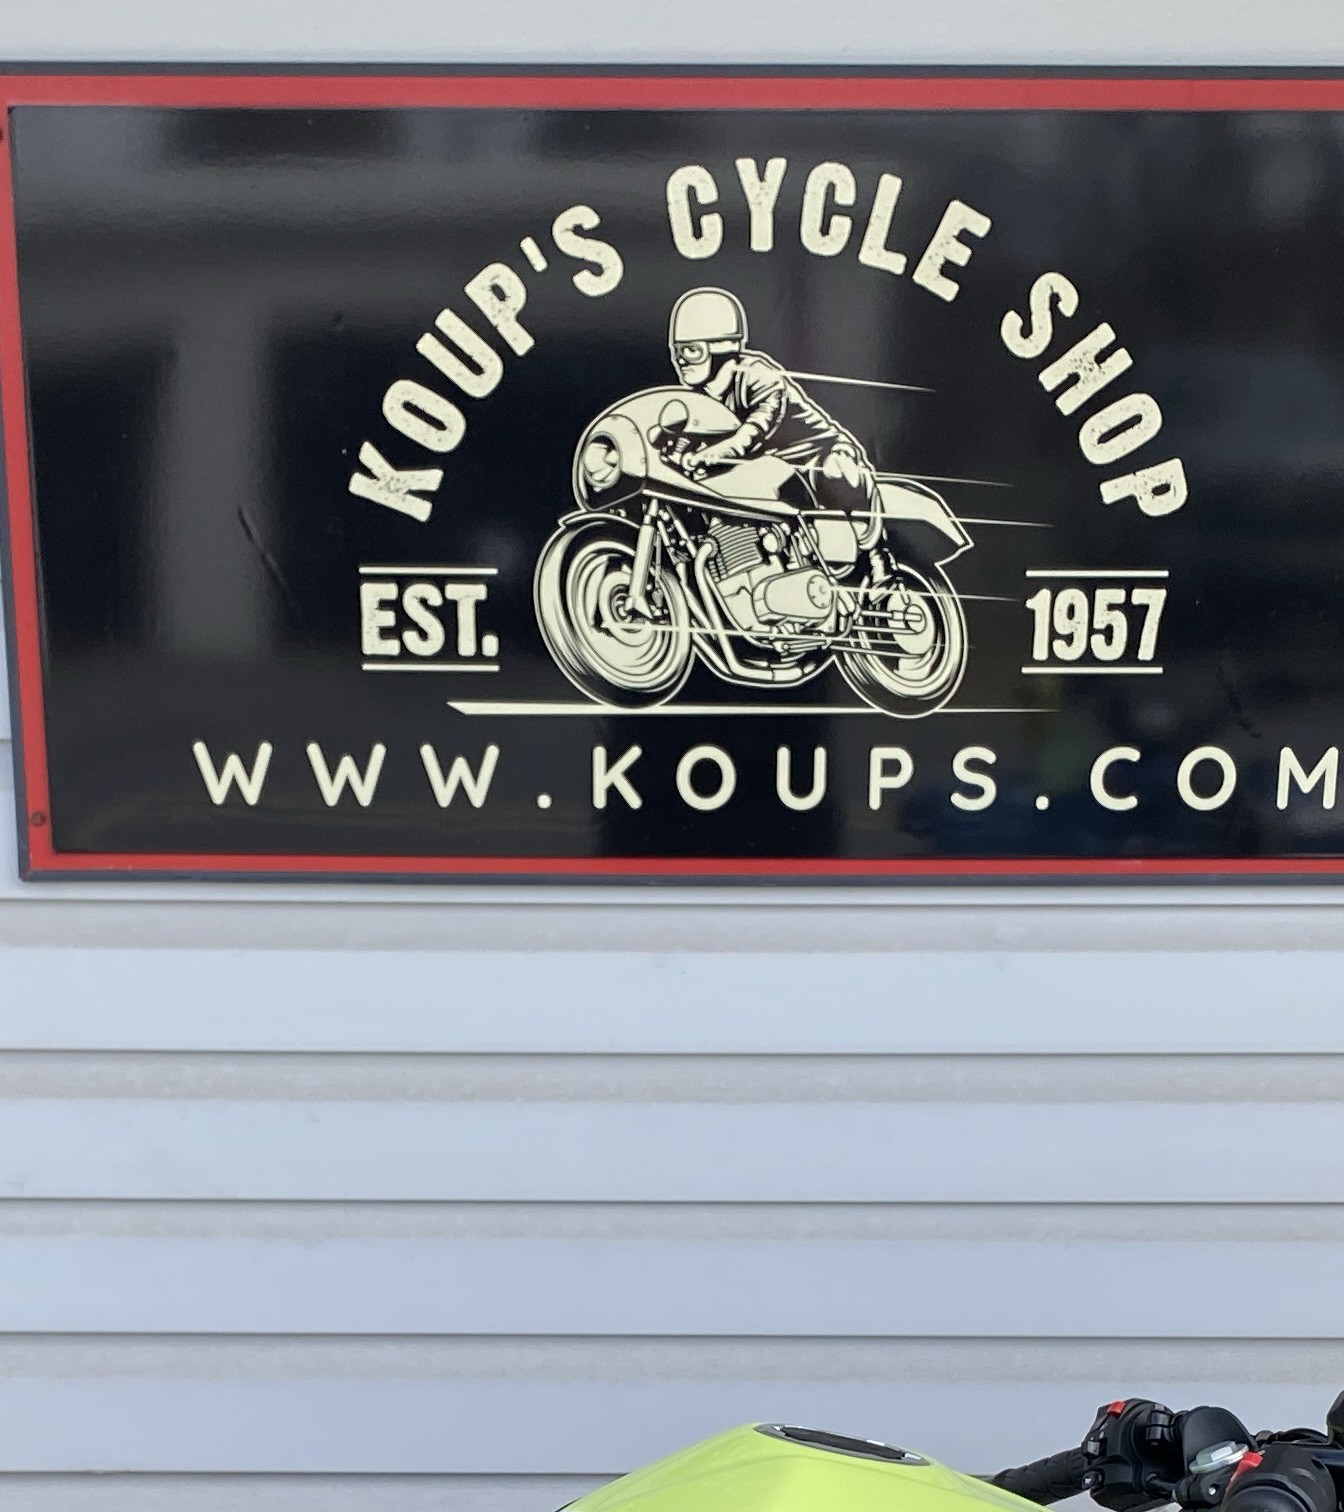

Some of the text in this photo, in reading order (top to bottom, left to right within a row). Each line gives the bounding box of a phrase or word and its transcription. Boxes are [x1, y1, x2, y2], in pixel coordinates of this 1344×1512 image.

[349, 157, 1188, 522] KOUP'S CYCLE SHOP
[361, 582, 499, 657] EST.
[1025, 588, 1167, 661] 1957
[192, 741, 1339, 812] WWW.KOUPS.COM
